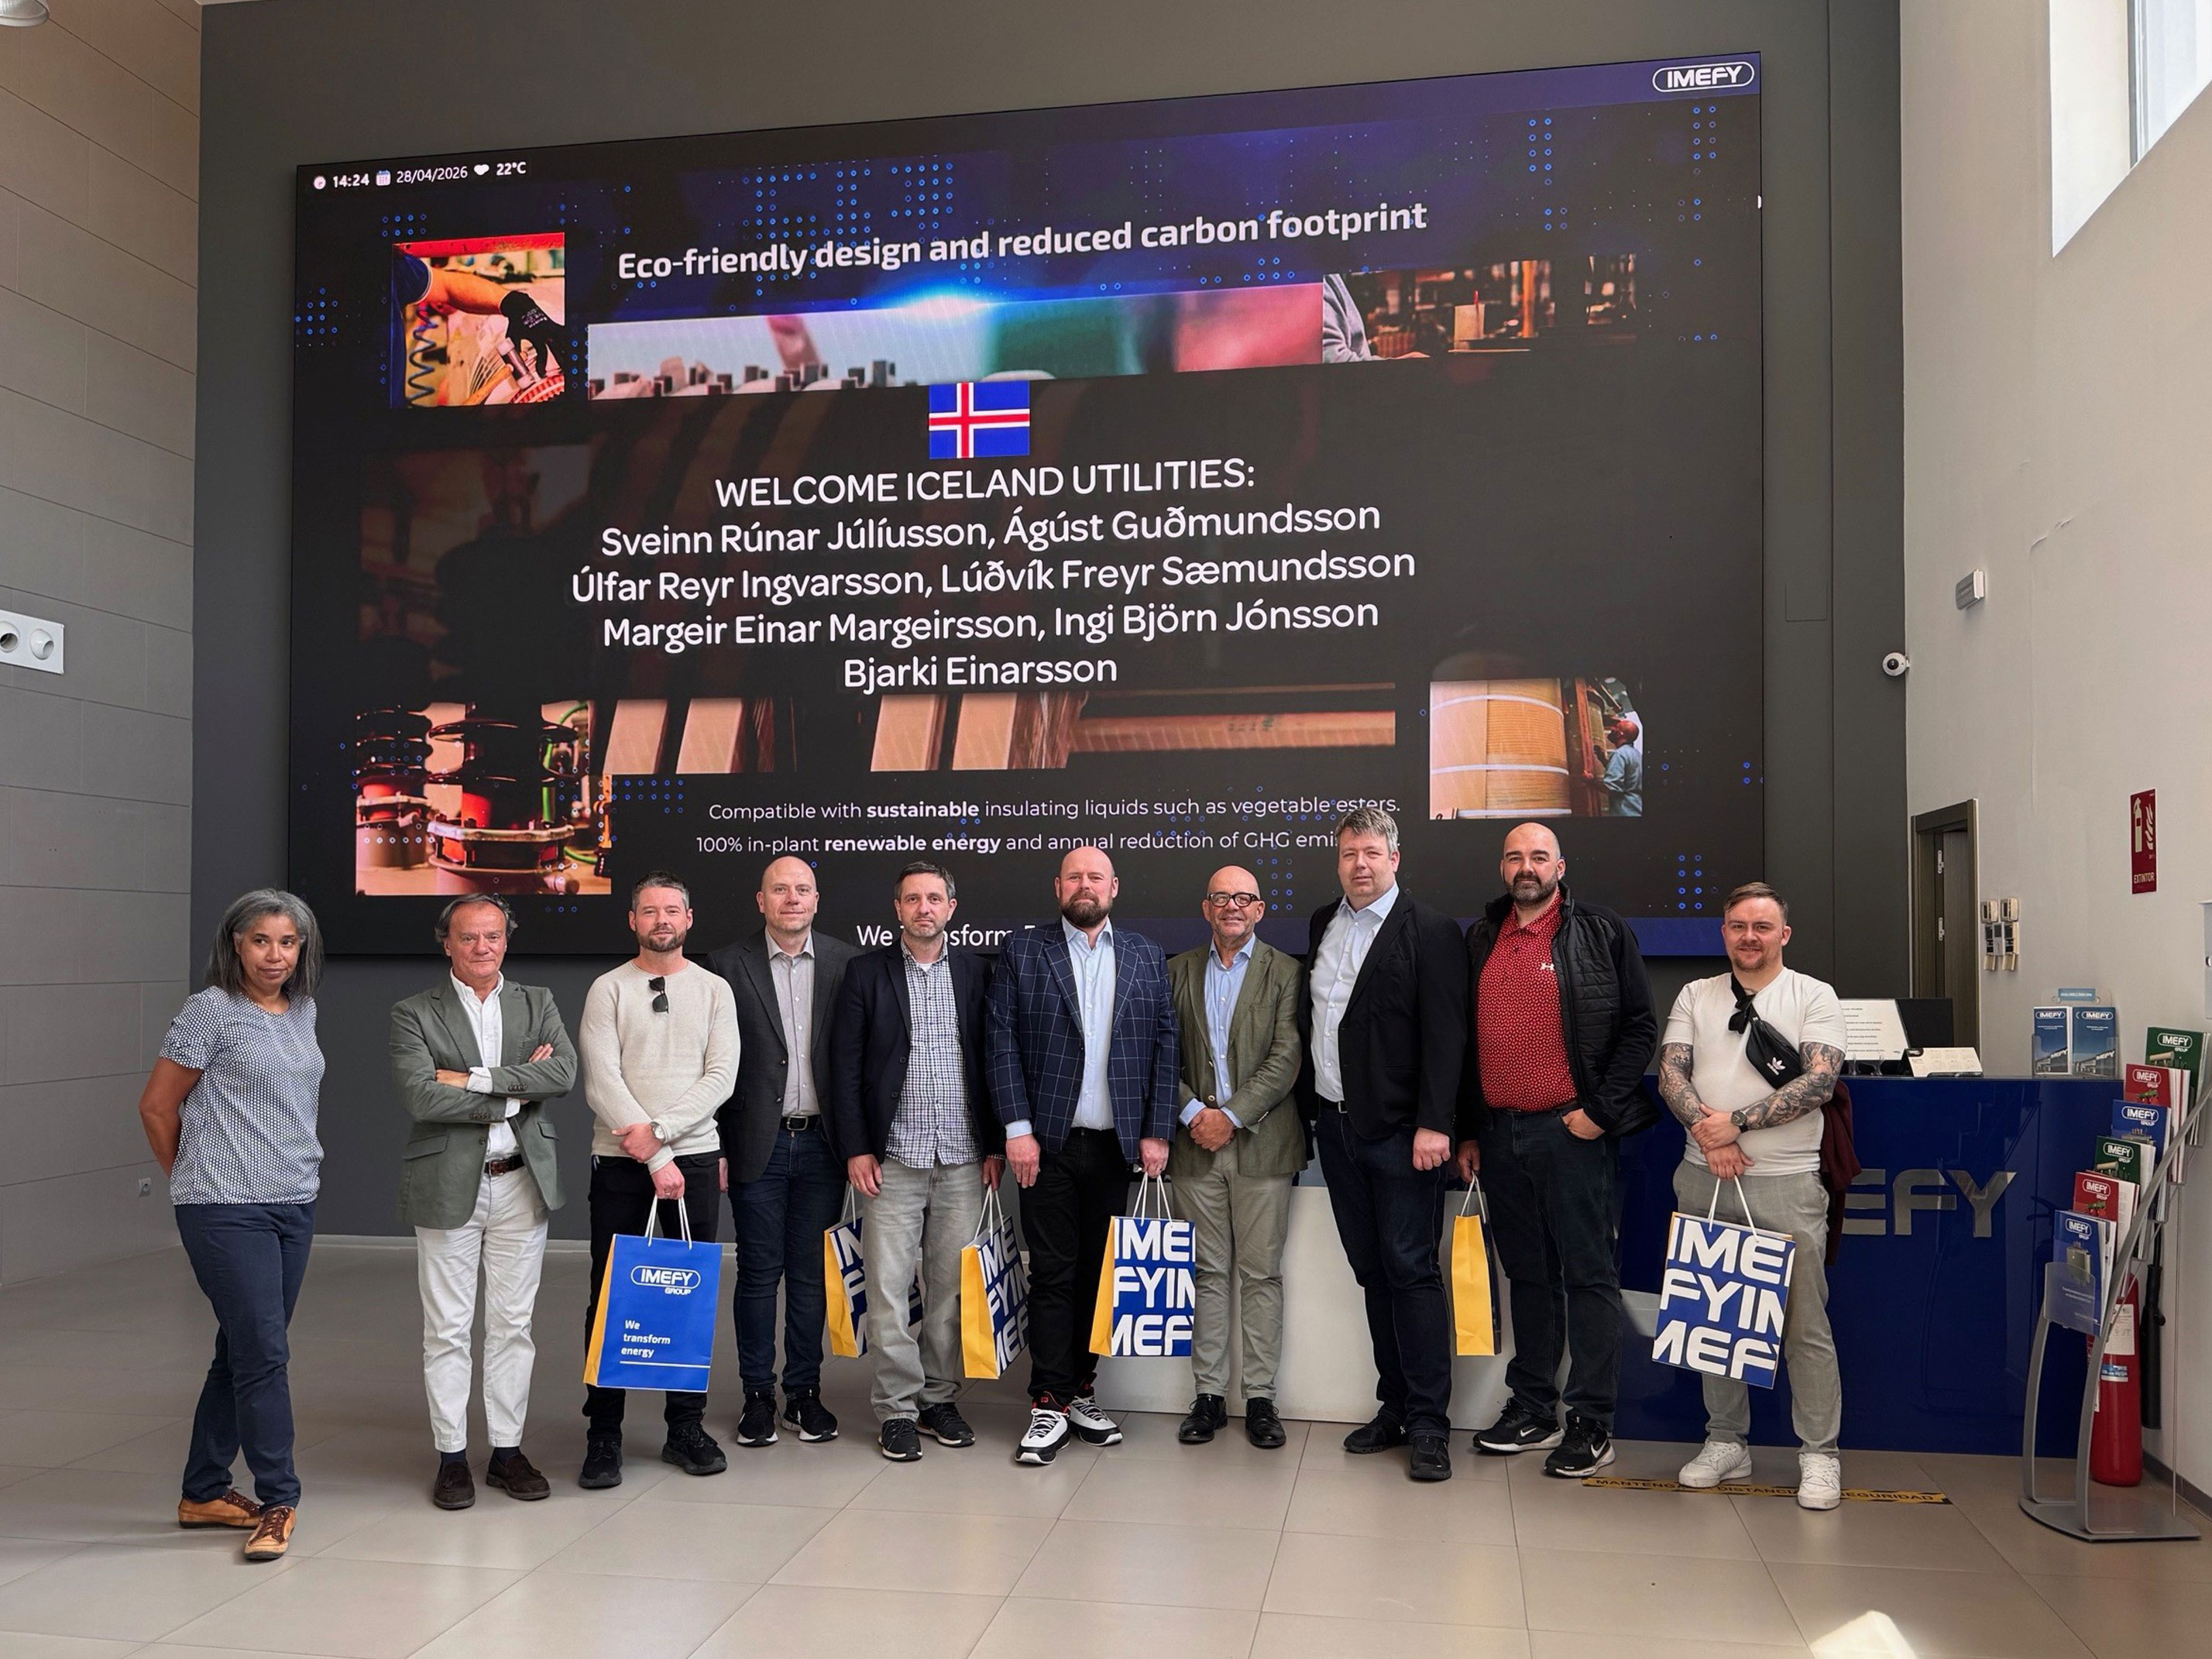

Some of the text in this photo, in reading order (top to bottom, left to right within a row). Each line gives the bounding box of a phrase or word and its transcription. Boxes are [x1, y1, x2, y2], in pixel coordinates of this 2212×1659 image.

[1667, 65, 1743, 88] IMEFY
[332, 161, 527, 188] 14:24 28/04/2026 22°C
[619, 203, 1427, 279] Eco-friendly design and reduced carbon footprint
[715, 458, 1255, 507] WELCOME ICELAND UTILITIES:
[602, 503, 1380, 556] Sveinn Rúnar Júlíusson, Ágúst Guðmundsson
[572, 549, 1415, 606] Úlfar Reyr Ingvarsson, Lúðvík Freyr Sæmundsson
[604, 599, 1379, 653] Margeir Einar Margeirsson, Ingi Björn Jónsson
[844, 654, 1117, 696] Bjarki Einarsson
[709, 802, 816, 823] Compatible
[820, 802, 861, 819] with
[867, 800, 980, 819] sustainable
[985, 799, 1079, 823] insulating
[1085, 798, 1149, 819] liquids
[1153, 798, 1200, 816] such
[1205, 802, 1227, 814] as
[1231, 796, 1331, 817] vegetable
[696, 836, 743, 853] 100%
[748, 835, 819, 857] in-plant
[825, 834, 927, 852] renewable
[932, 834, 1001, 856] energy
[1006, 833, 1042, 850] and
[1048, 833, 1113, 850] annual
[1120, 831, 1214, 849] reduction
[1219, 831, 1240, 848] of
[1244, 831, 1293, 848] GHG
[856, 925, 893, 946] We
[2162, 1035, 2189, 1046] IMEFY
[2136, 1071, 2158, 1082] IMEFY
[2127, 1108, 2155, 1120] IMEFY
[2107, 1145, 2130, 1157] IMEFY
[1842, 1168, 2018, 1238] EFY
[1114, 1218, 1196, 1262] IME
[1667, 1217, 1796, 1287] IME
[641, 1268, 693, 1286] IMEFY
[665, 1287, 692, 1296] GROUP
[624, 1319, 641, 1330] We
[621, 1347, 654, 1358] energy
[623, 1334, 671, 1345] transform
